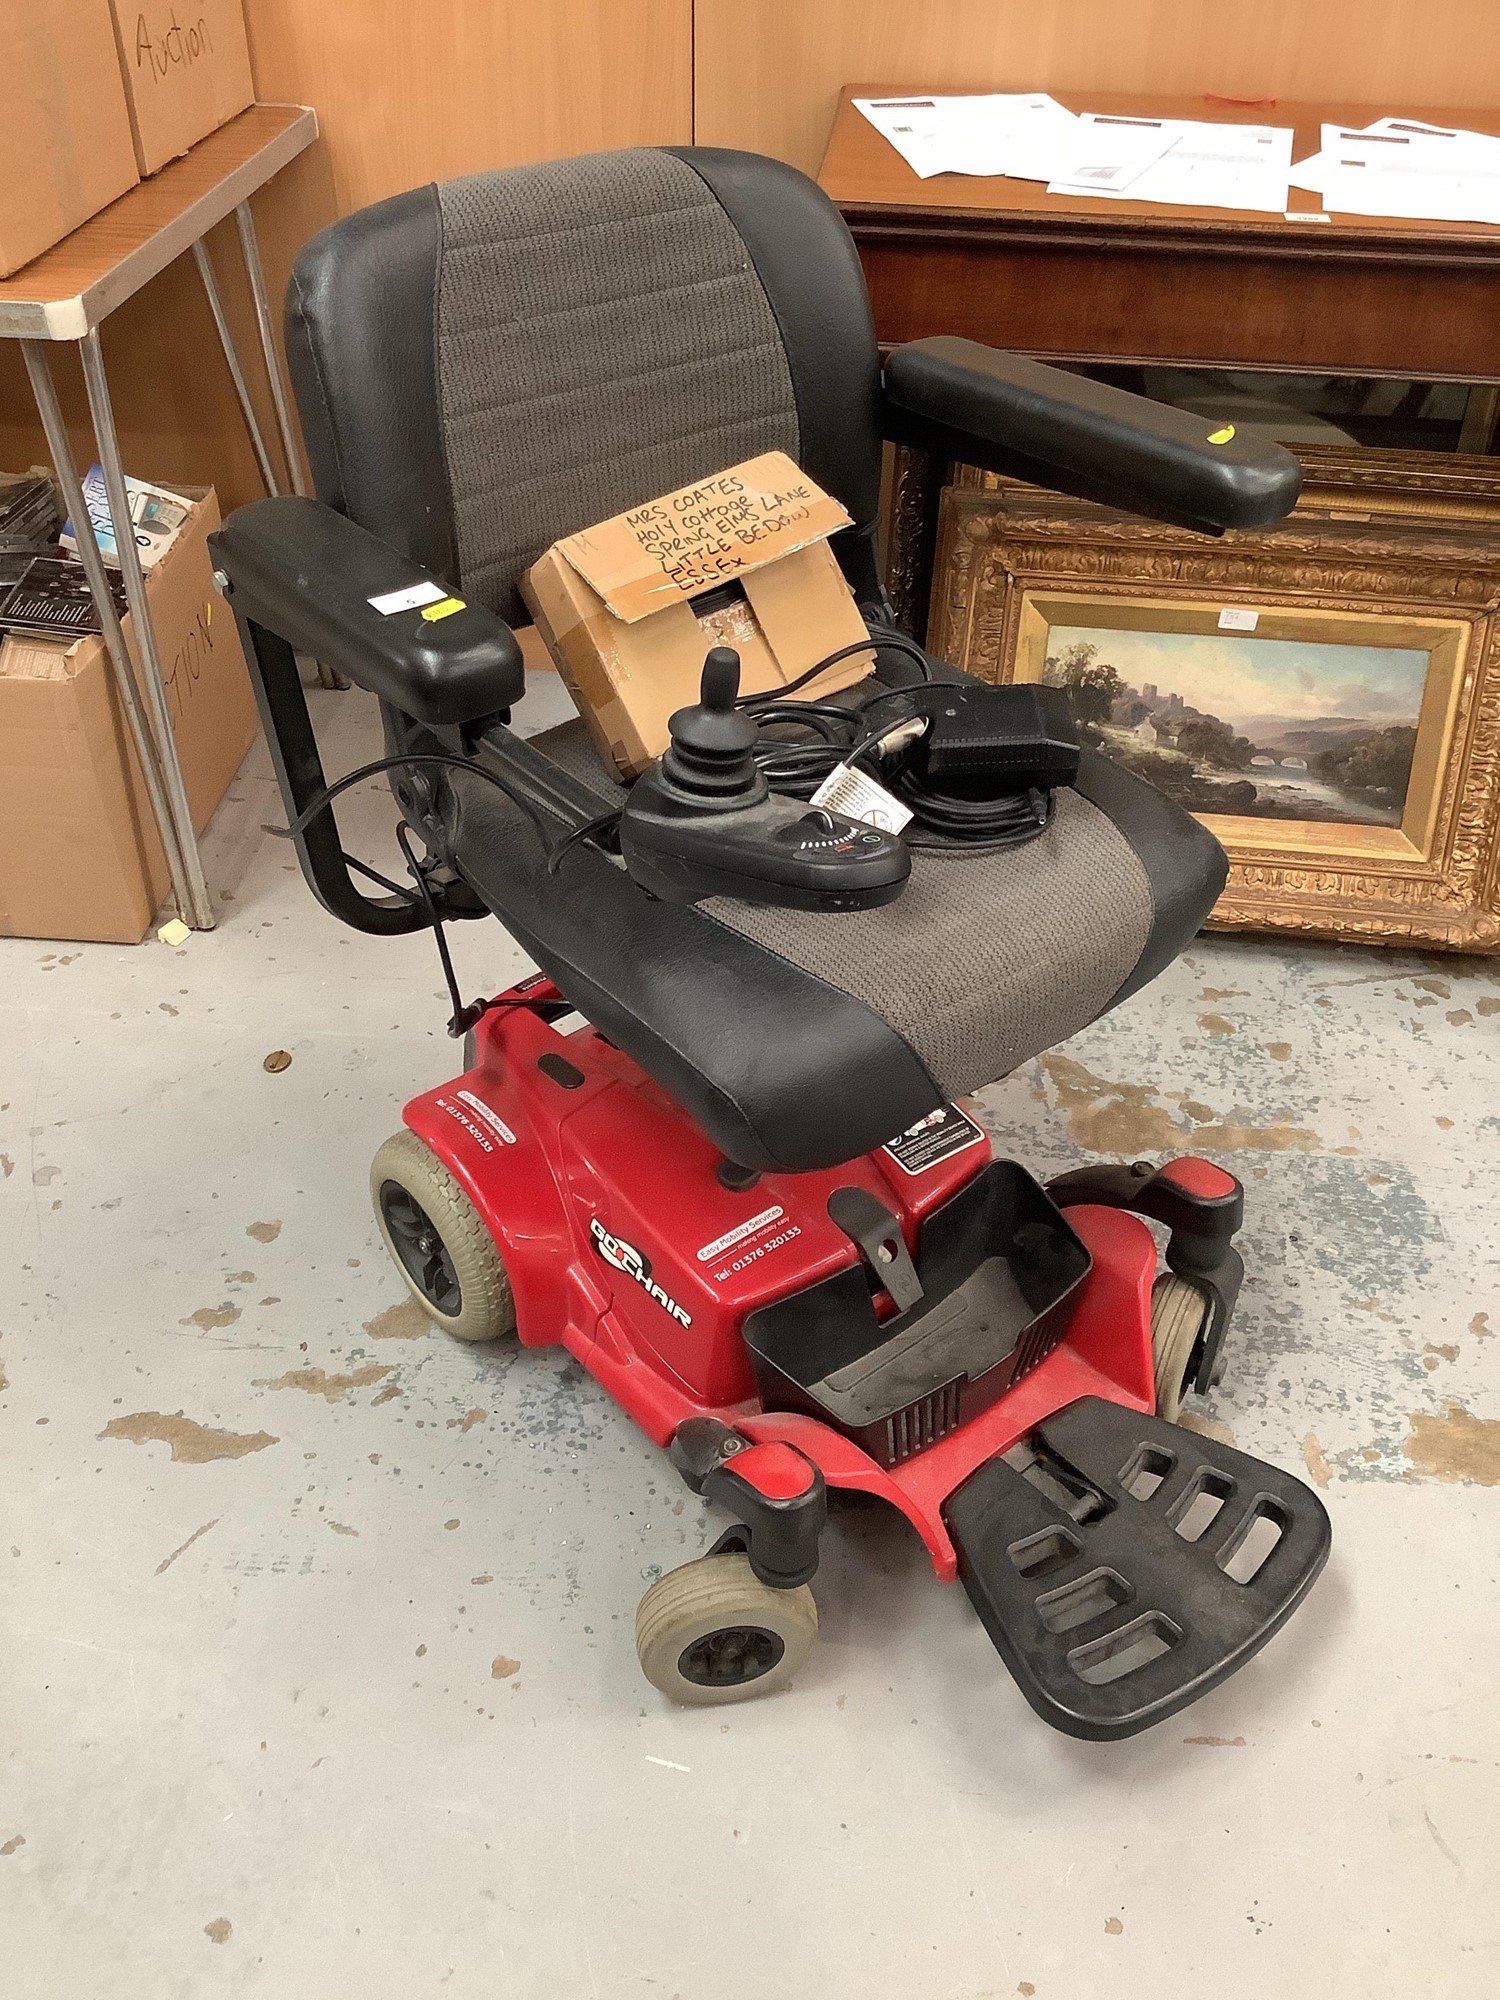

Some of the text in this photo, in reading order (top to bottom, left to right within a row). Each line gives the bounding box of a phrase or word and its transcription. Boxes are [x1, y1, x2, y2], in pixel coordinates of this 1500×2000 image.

[136, 8, 214, 85] Auction
[626, 476, 744, 529] MRS COATES
[645, 527, 715, 560] SPRING
[760, 486, 811, 512] LANE
[661, 538, 732, 574] LITTLE
[445, 1106, 470, 1125] 01376
[465, 1124, 494, 1153] 320133
[472, 1100, 493, 1118] Mobility
[491, 1117, 514, 1142] Services
[700, 1207, 782, 1259] Easy Mobility Services
[713, 1225, 802, 1282] Tel: 01376 320133
[620, 1251, 693, 1330] CHAIR
